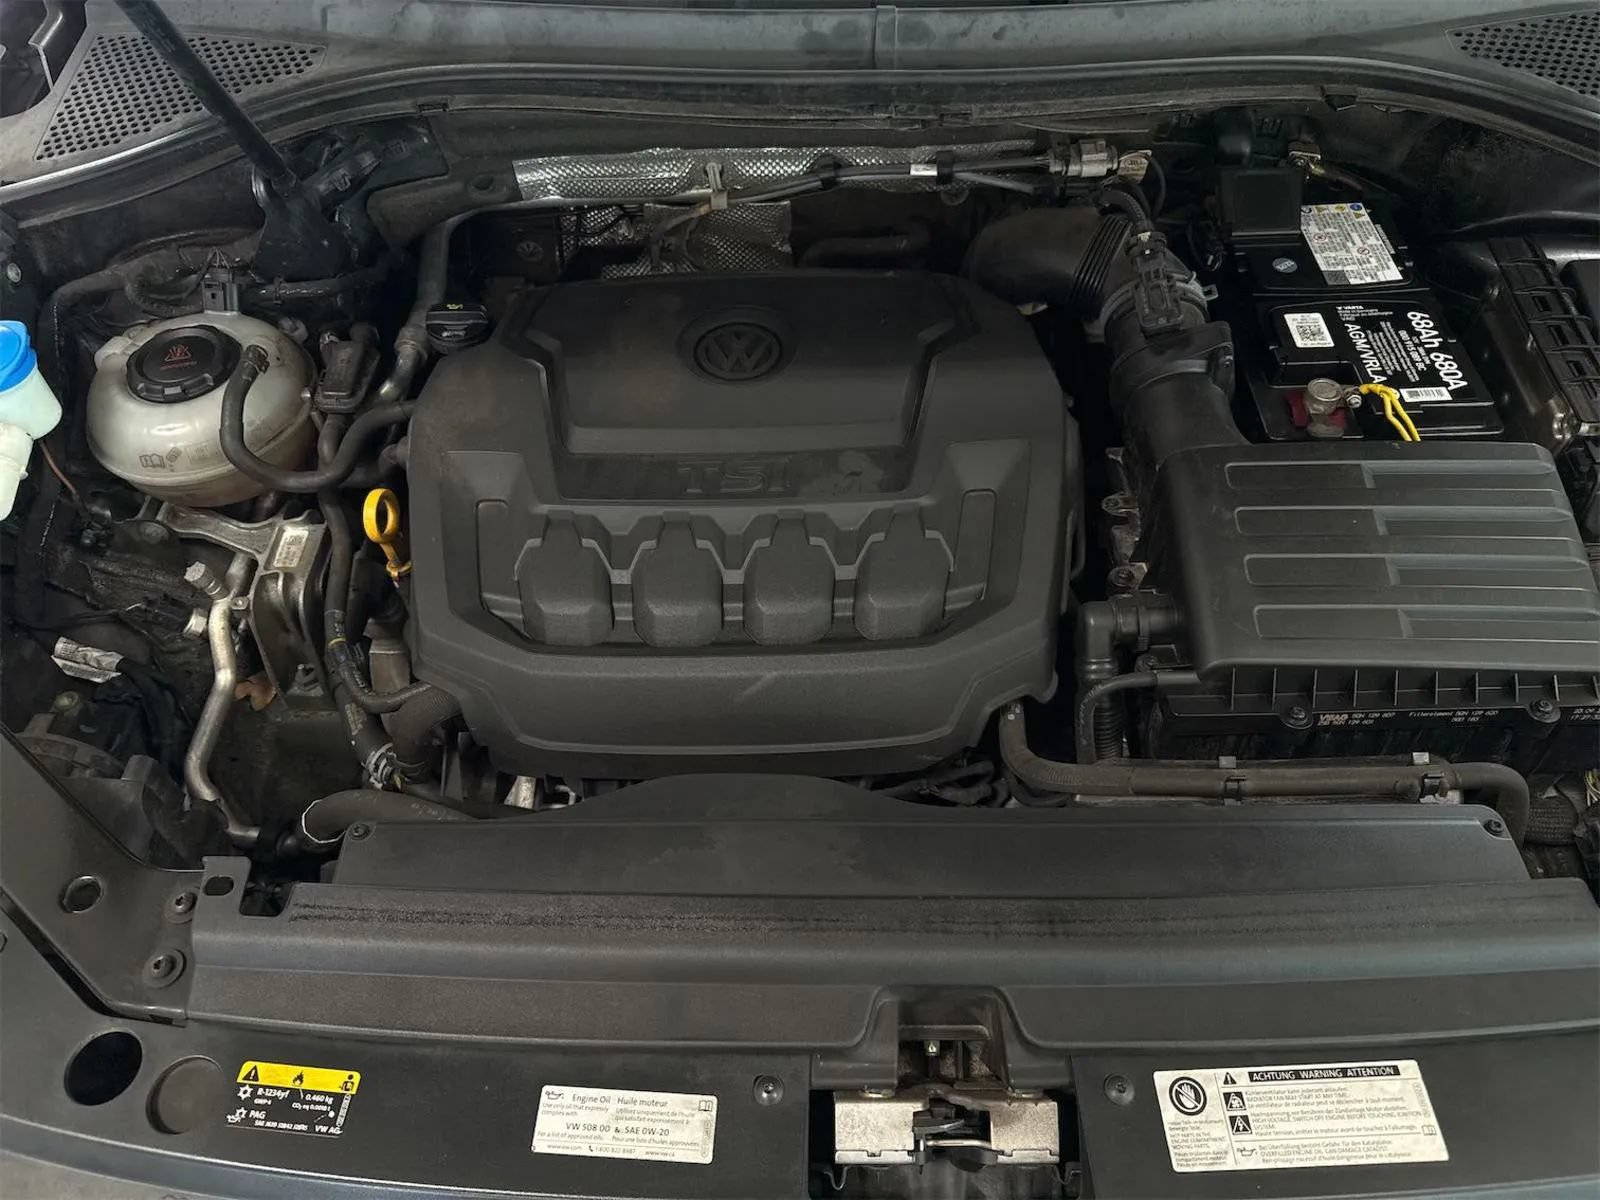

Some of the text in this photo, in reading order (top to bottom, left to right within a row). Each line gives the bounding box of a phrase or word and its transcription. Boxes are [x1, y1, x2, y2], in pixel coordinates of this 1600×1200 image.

[1344, 322, 1389, 384] AGM/VRLA
[1407, 311, 1469, 390] 68Ah 680A
[677, 458, 792, 493] TSI
[1252, 1066, 1395, 1081] ACHTUNG WARNING ATTENTION
[257, 1087, 334, 1104] R-1234yf 0.460 kg
[572, 1093, 668, 1107] Engine Oil Huile moteur
[249, 1110, 267, 1119] PAG
[315, 1125, 329, 1133] VW
[329, 1126, 341, 1134] AG
[566, 1121, 669, 1136] VW 508 00 & SAE 0W-20
